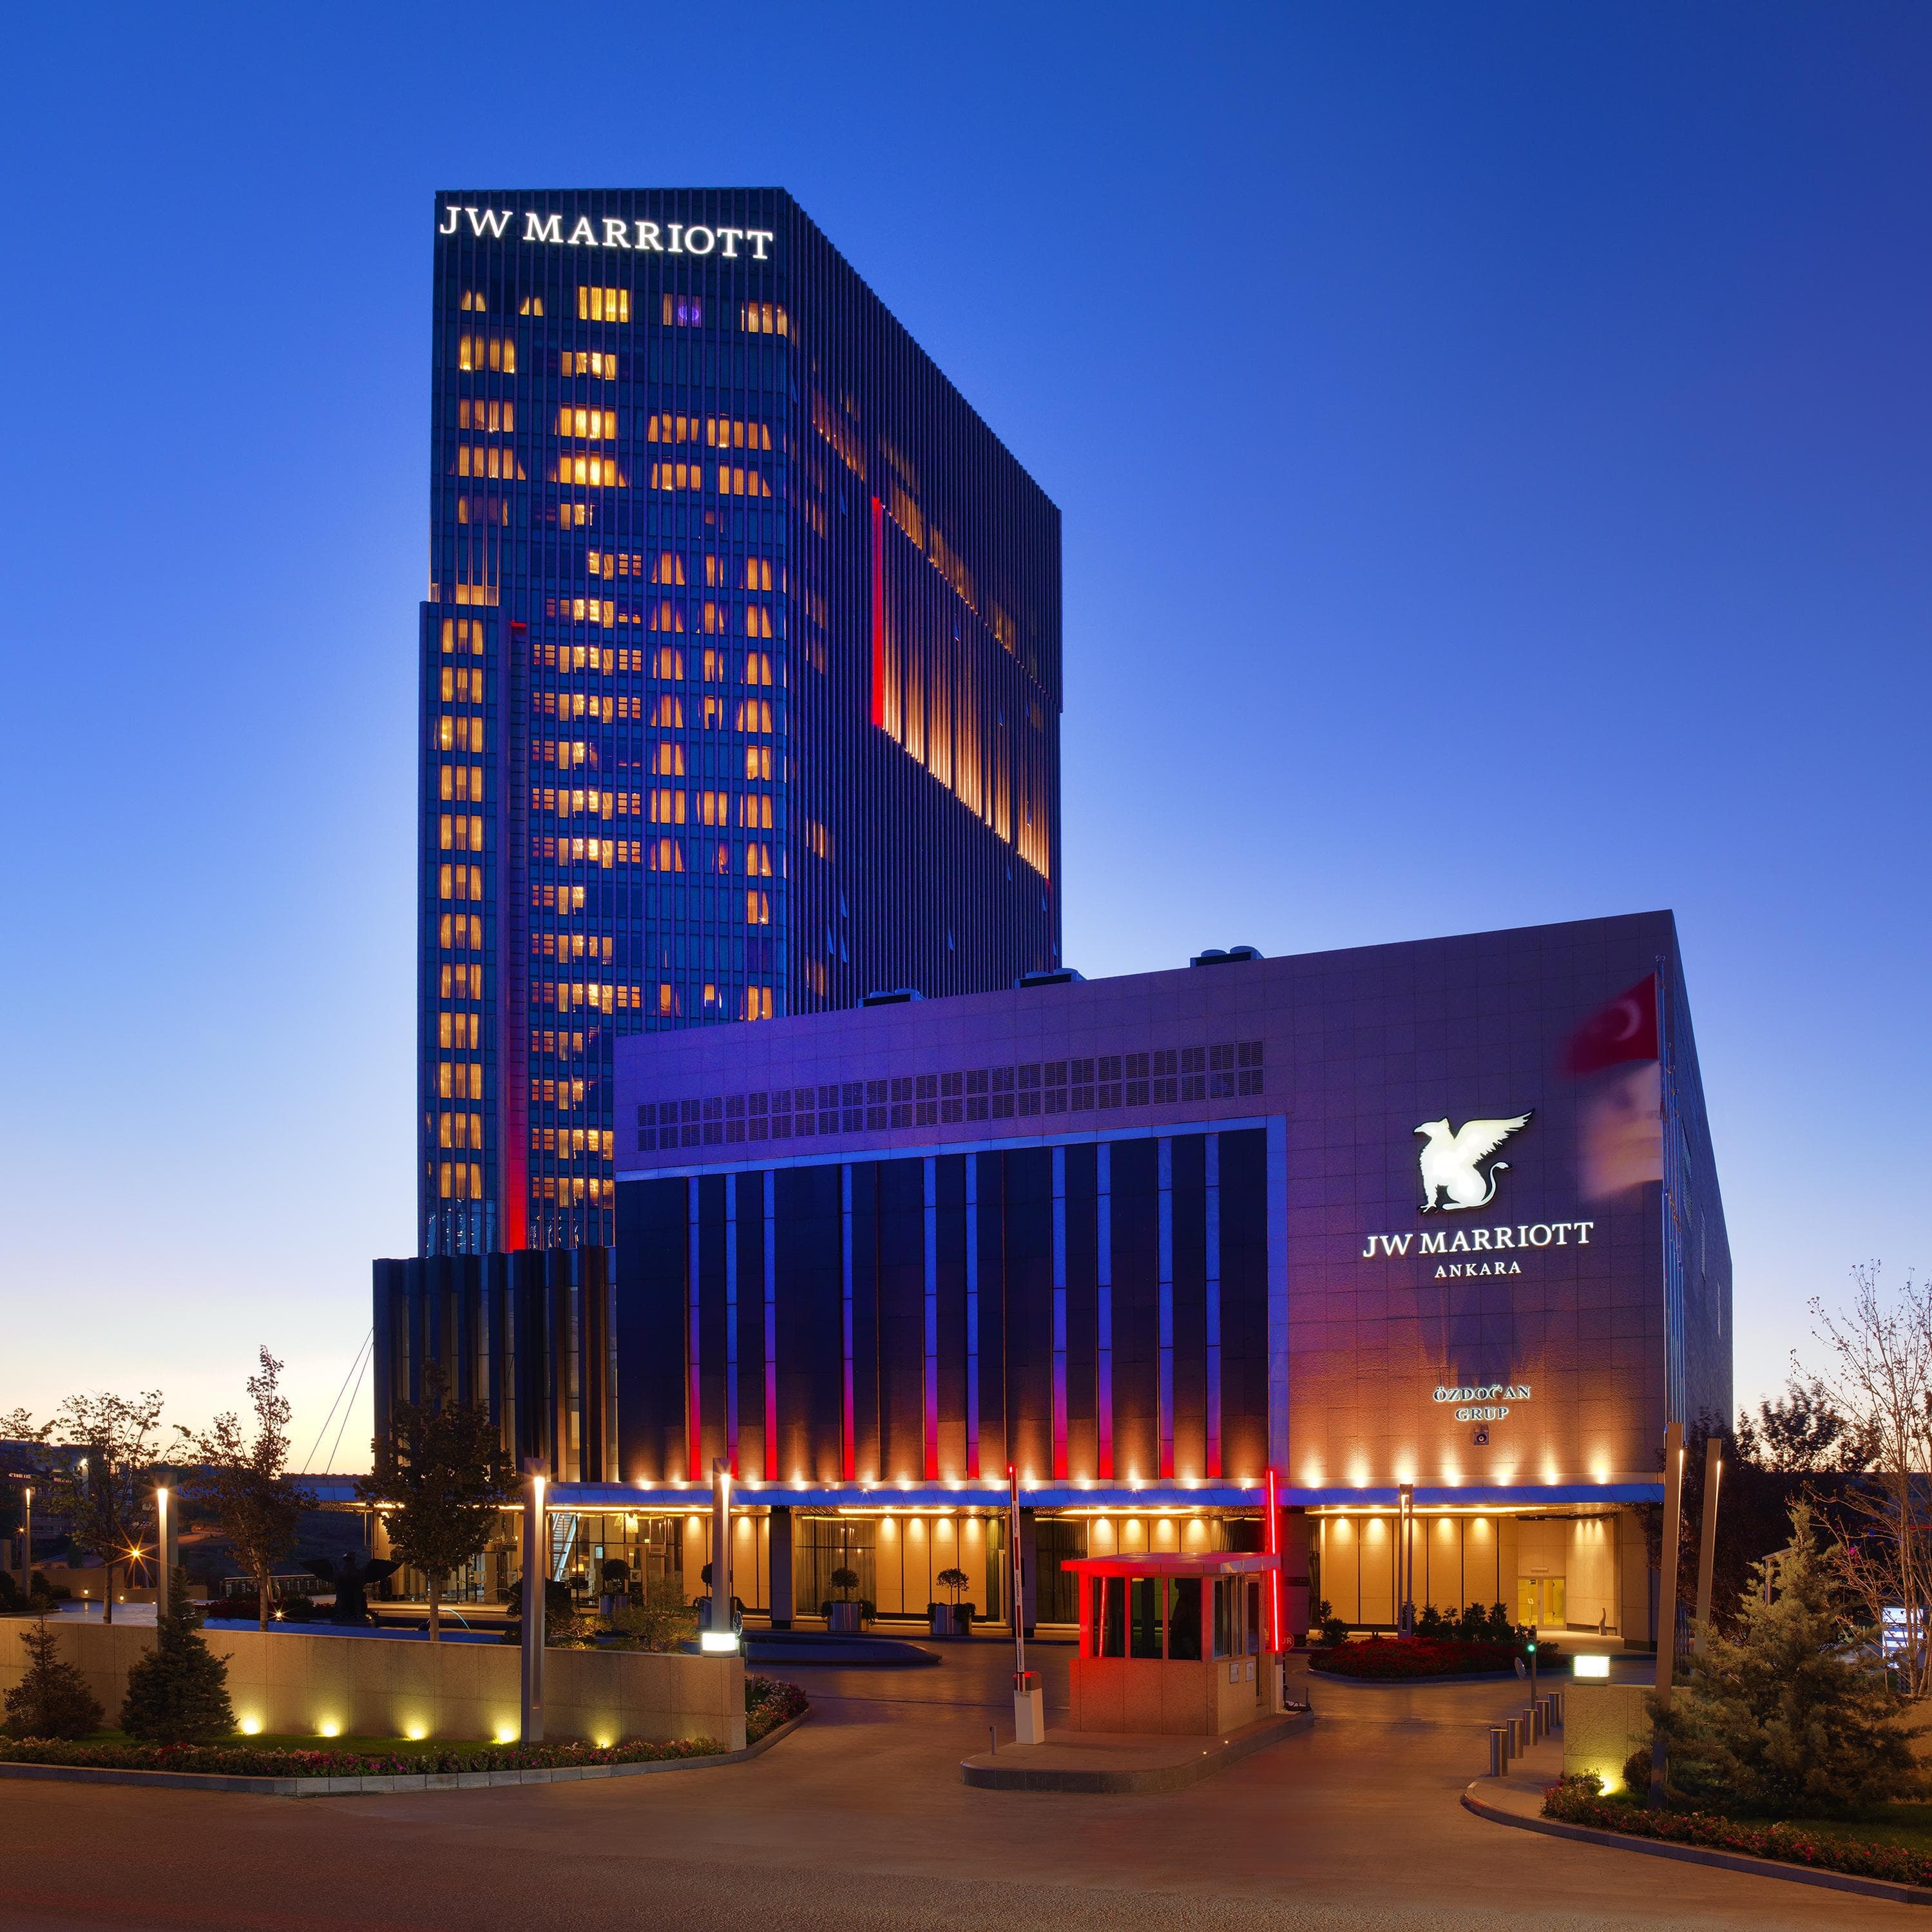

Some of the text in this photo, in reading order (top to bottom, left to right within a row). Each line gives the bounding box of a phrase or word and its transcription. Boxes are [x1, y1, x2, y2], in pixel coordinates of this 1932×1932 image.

[439, 206, 773, 260] JW MARRIOTT
[1363, 1221, 1594, 1258] JW MARRIOTT
[1434, 1261, 1522, 1278] ANKARA
[1455, 1407, 1509, 1421] GRUP
